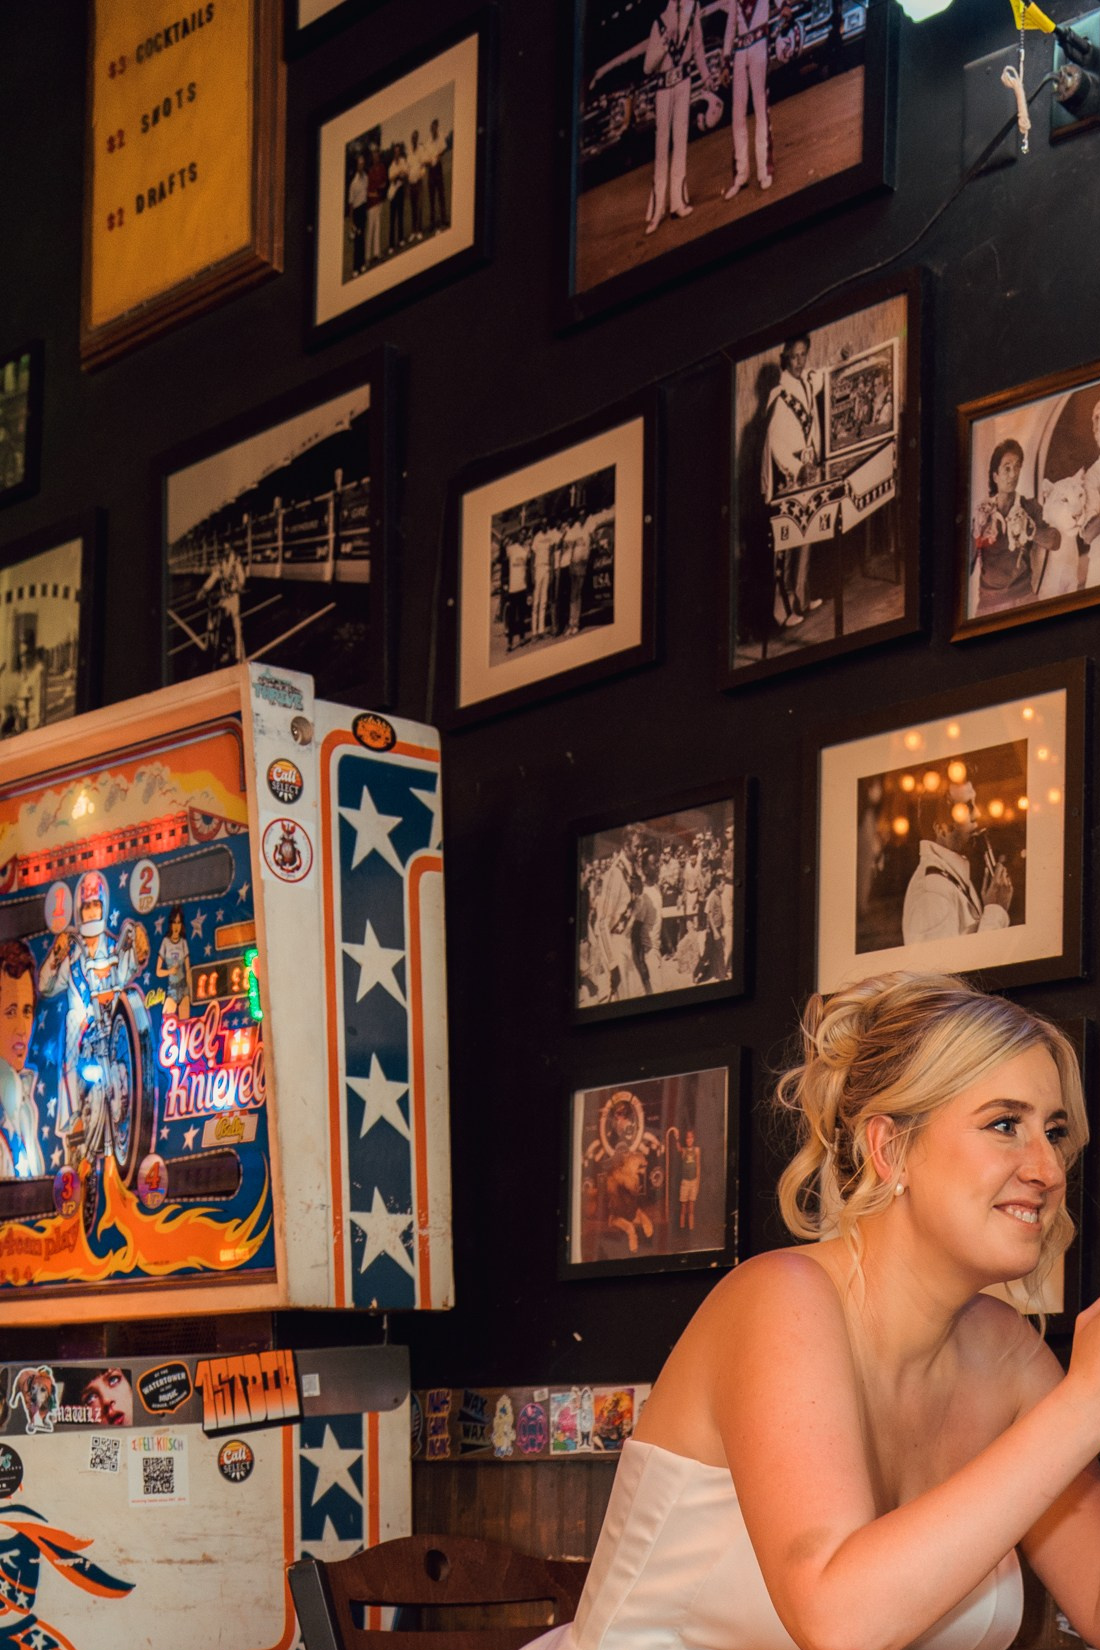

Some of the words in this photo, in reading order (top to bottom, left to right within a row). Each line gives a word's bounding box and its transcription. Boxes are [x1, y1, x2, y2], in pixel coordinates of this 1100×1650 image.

[135, 2, 215, 64] COCKTAILS
[136, 162, 198, 214] DRAFTS
[271, 780, 300, 795] SELECT
[139, 866, 154, 895] 2
[53, 887, 65, 917] 1
[158, 1001, 221, 1067] Evel
[166, 1046, 267, 1117] Knievel
[61, 1172, 74, 1199] 3
[145, 1160, 162, 1190] 4
[142, 1372, 187, 1395] WATERTOWER
[223, 1461, 251, 1475] SELECT
